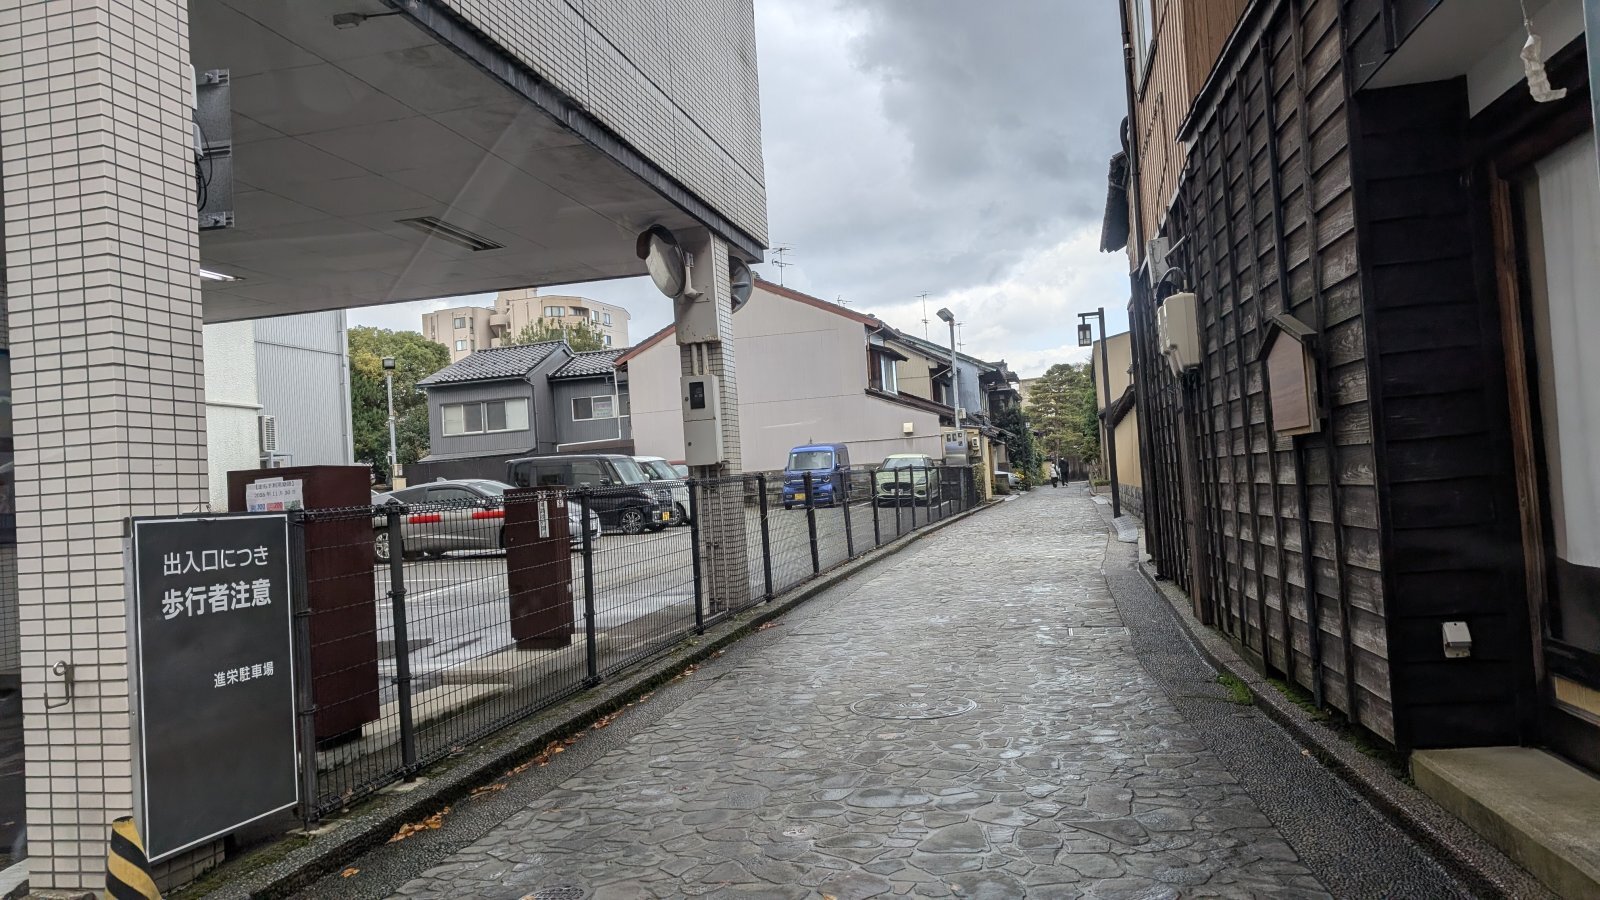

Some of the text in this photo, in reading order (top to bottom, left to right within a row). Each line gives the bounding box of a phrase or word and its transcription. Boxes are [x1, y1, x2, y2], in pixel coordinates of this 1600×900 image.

[163, 545, 269, 576] 出入口につき
[161, 578, 272, 620] 歩行者注意
[213, 661, 274, 688] 進栄駐車場
